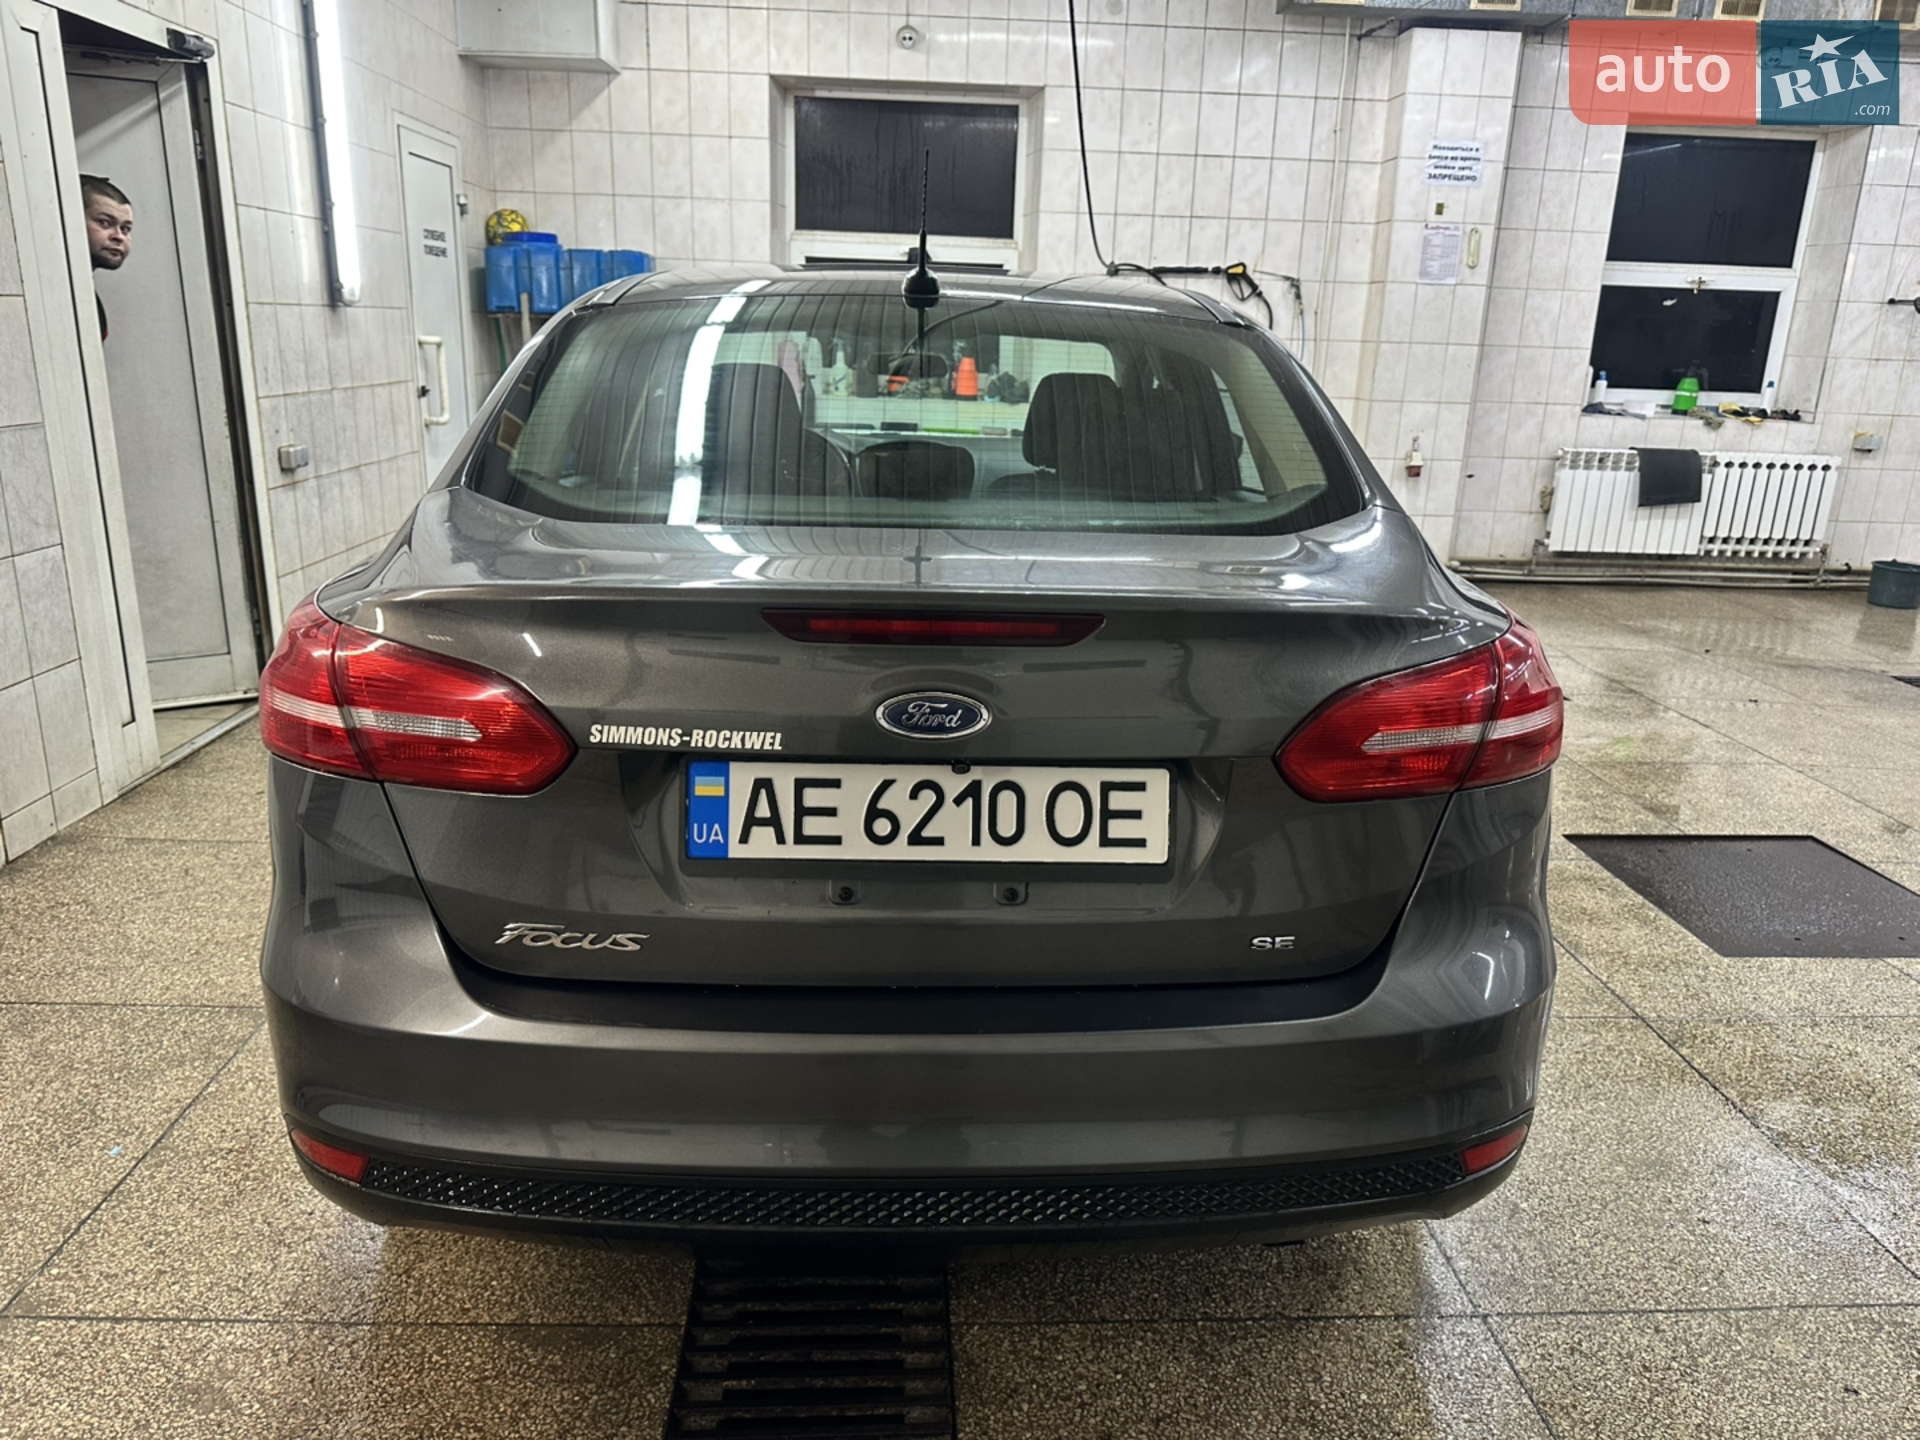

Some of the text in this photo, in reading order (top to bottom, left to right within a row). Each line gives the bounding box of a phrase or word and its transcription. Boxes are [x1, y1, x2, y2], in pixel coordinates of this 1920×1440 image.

[1428, 173, 1477, 182] ЗАПРЕЩЕНО
[901, 701, 963, 728] Ford
[589, 723, 783, 751] SIMMONS-ROCKWEL
[738, 777, 1147, 848] AE 6210 OE
[693, 823, 724, 844] UA
[1250, 936, 1295, 950] SE
